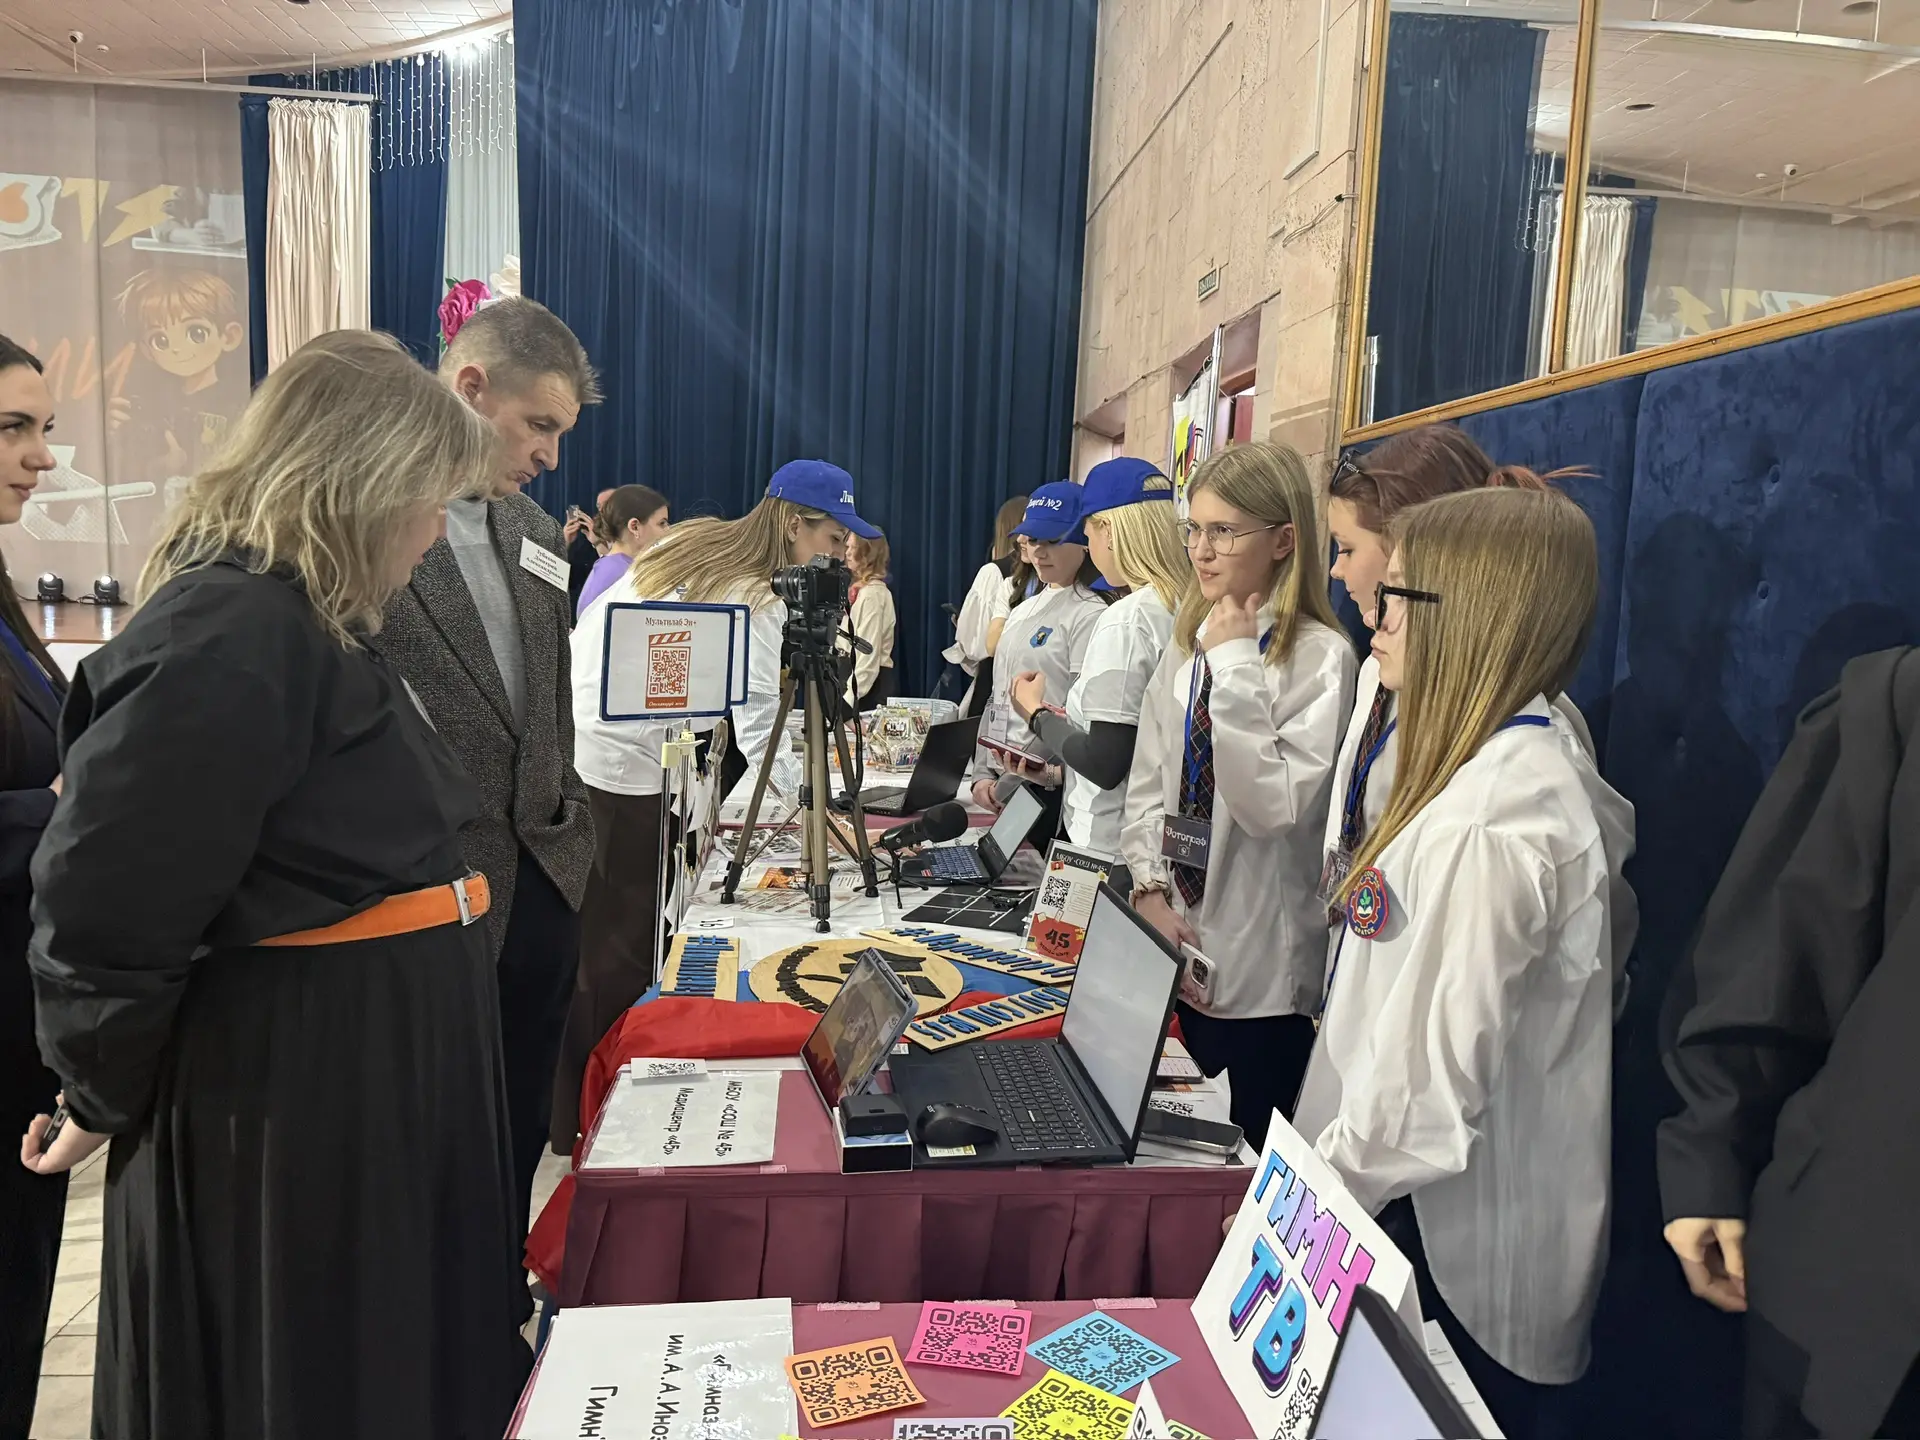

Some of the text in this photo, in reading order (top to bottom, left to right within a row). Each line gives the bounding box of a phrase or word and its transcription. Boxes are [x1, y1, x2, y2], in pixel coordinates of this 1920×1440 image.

[645, 617, 683, 626] Мультилаб
[1165, 825, 1207, 847] Фотограф
[725, 1080, 743, 1102] МБОУ
[662, 1087, 695, 1156] Медиацентр «45»
[1254, 1149, 1376, 1337] ГИМН
[1229, 1233, 1307, 1395] ТВ
